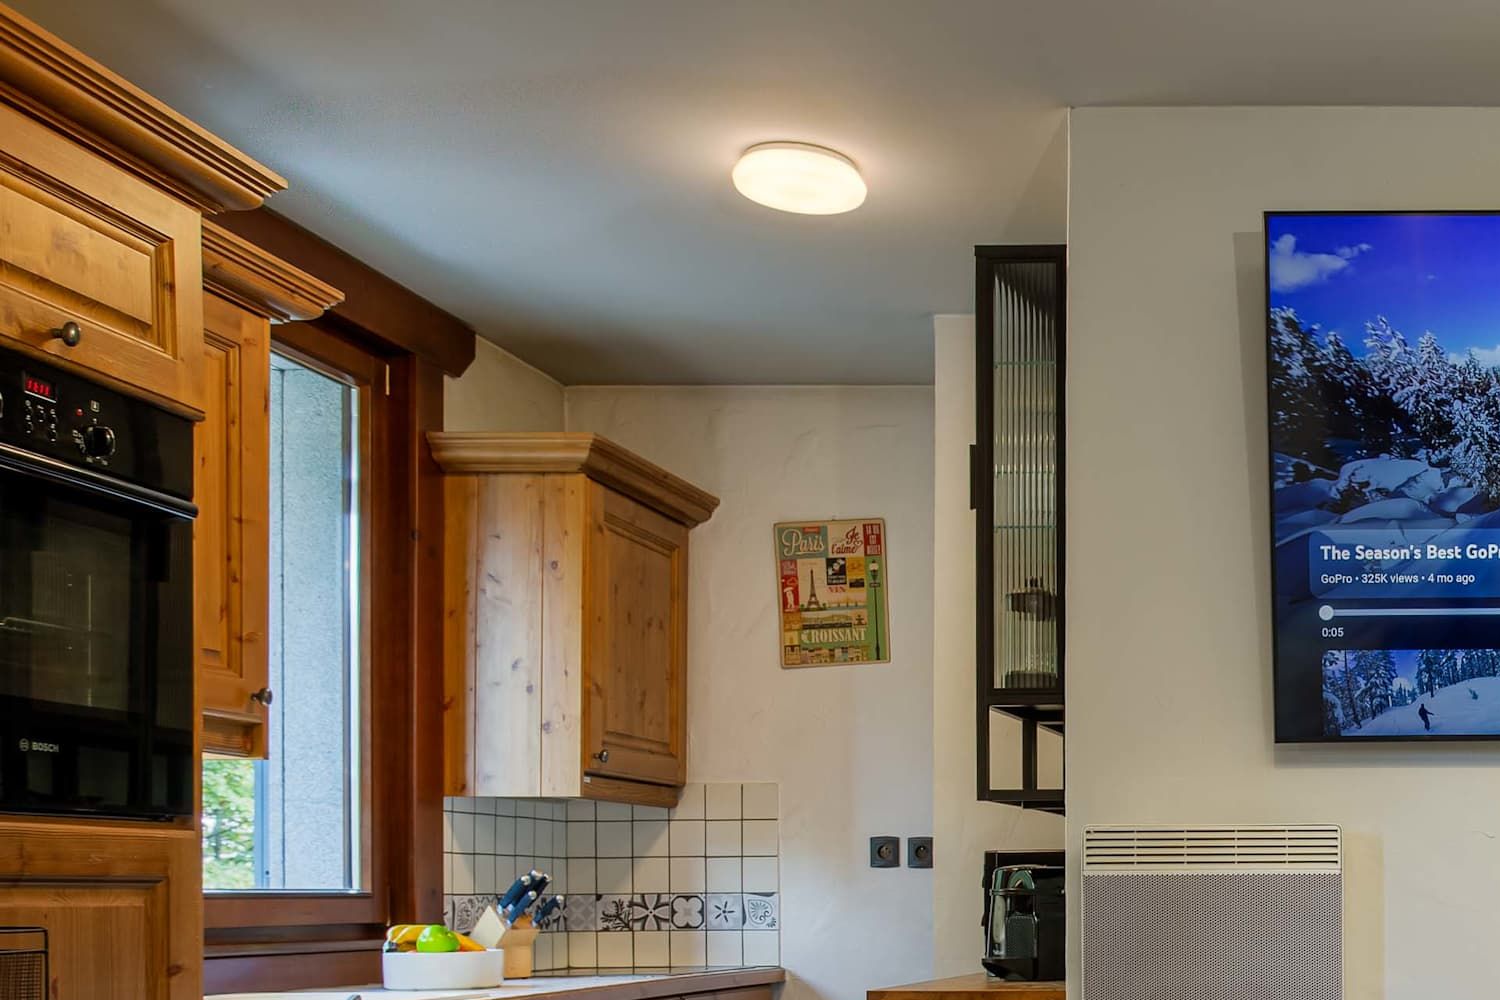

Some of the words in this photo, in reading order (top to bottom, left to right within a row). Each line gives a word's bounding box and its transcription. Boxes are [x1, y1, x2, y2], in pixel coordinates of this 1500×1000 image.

[782, 529, 824, 556] Paris
[1320, 545, 1350, 560] The
[1355, 544, 1422, 560] Season's
[1426, 544, 1462, 560] Best
[1320, 573, 1353, 584] GoPro
[1361, 573, 1388, 584] 325K
[1390, 573, 1419, 584] views
[1427, 573, 1434, 583] 4
[1436, 575, 1454, 584] mo
[1455, 575, 1475, 586] ago
[801, 628, 866, 644] CROISSANT
[1321, 627, 1344, 638] 0:05
[31, 741, 60, 753] BOSCH
